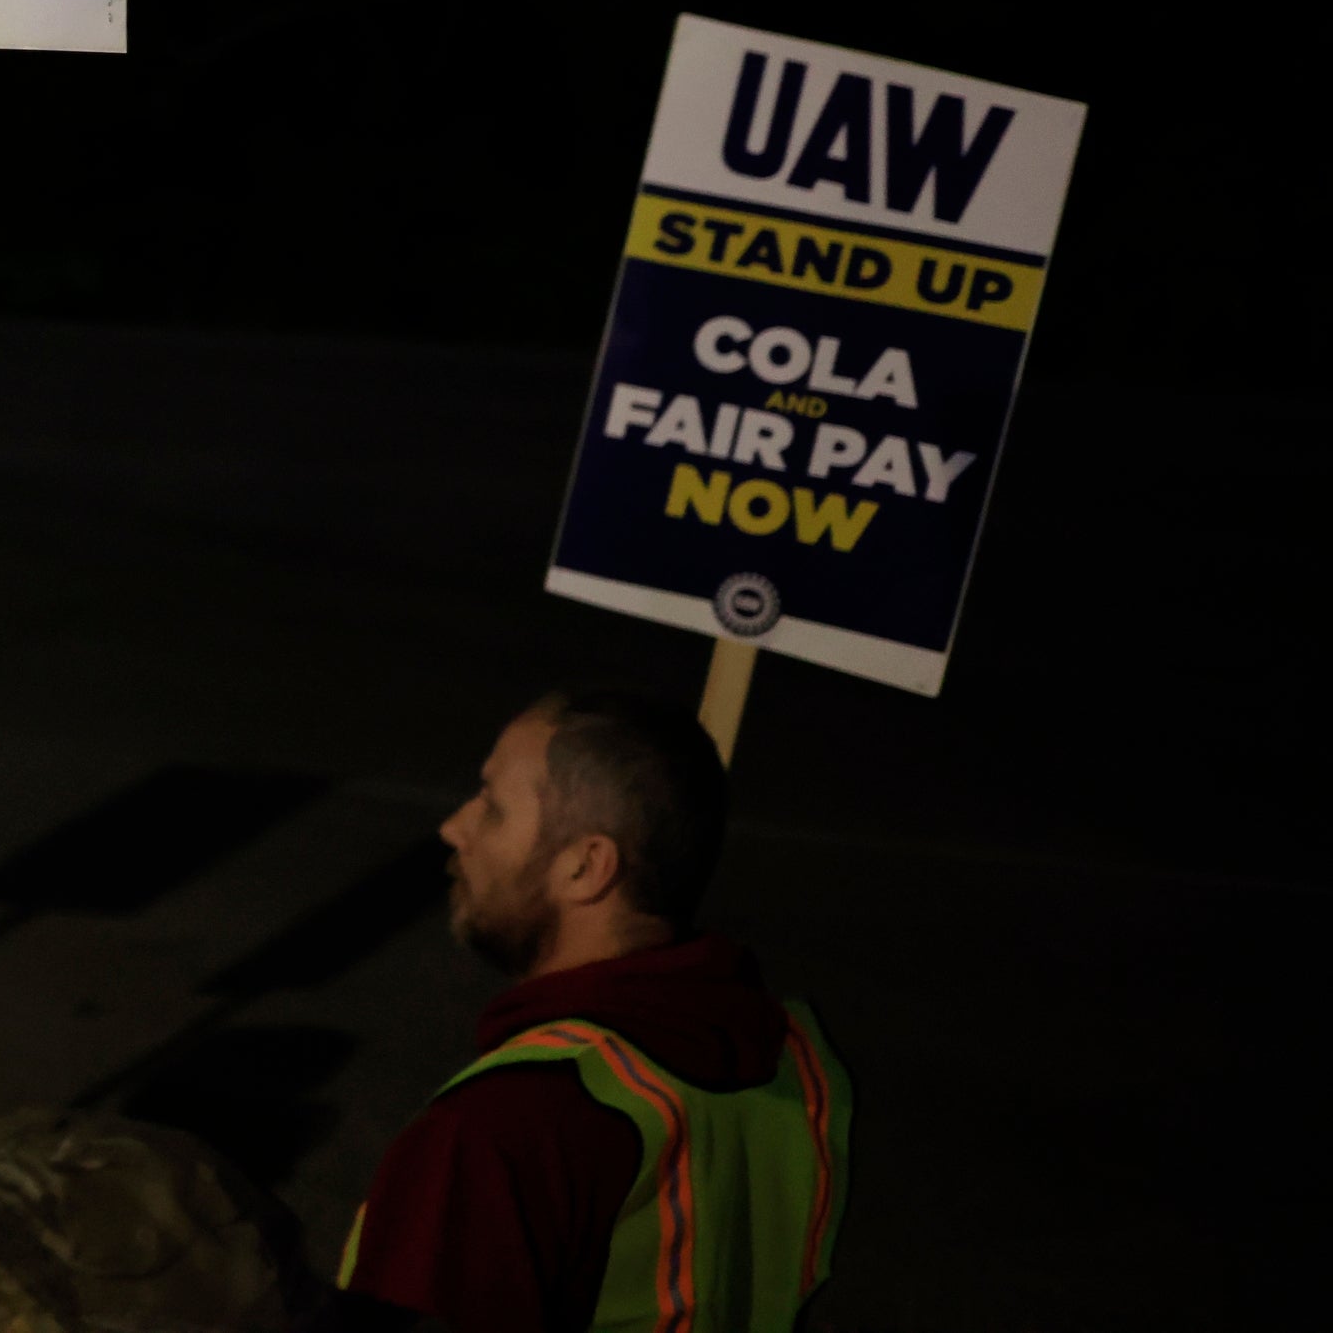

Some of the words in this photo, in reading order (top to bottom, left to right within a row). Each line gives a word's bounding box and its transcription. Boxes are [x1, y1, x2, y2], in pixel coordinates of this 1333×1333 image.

[722, 52, 1015, 223] UAW
[653, 212, 892, 291] STAND
[917, 259, 1013, 312] UP
[692, 314, 920, 410] COLA
[766, 389, 829, 420] AND
[602, 382, 797, 472] FAIR
[808, 422, 978, 505] PAY
[663, 464, 879, 553] NOW
